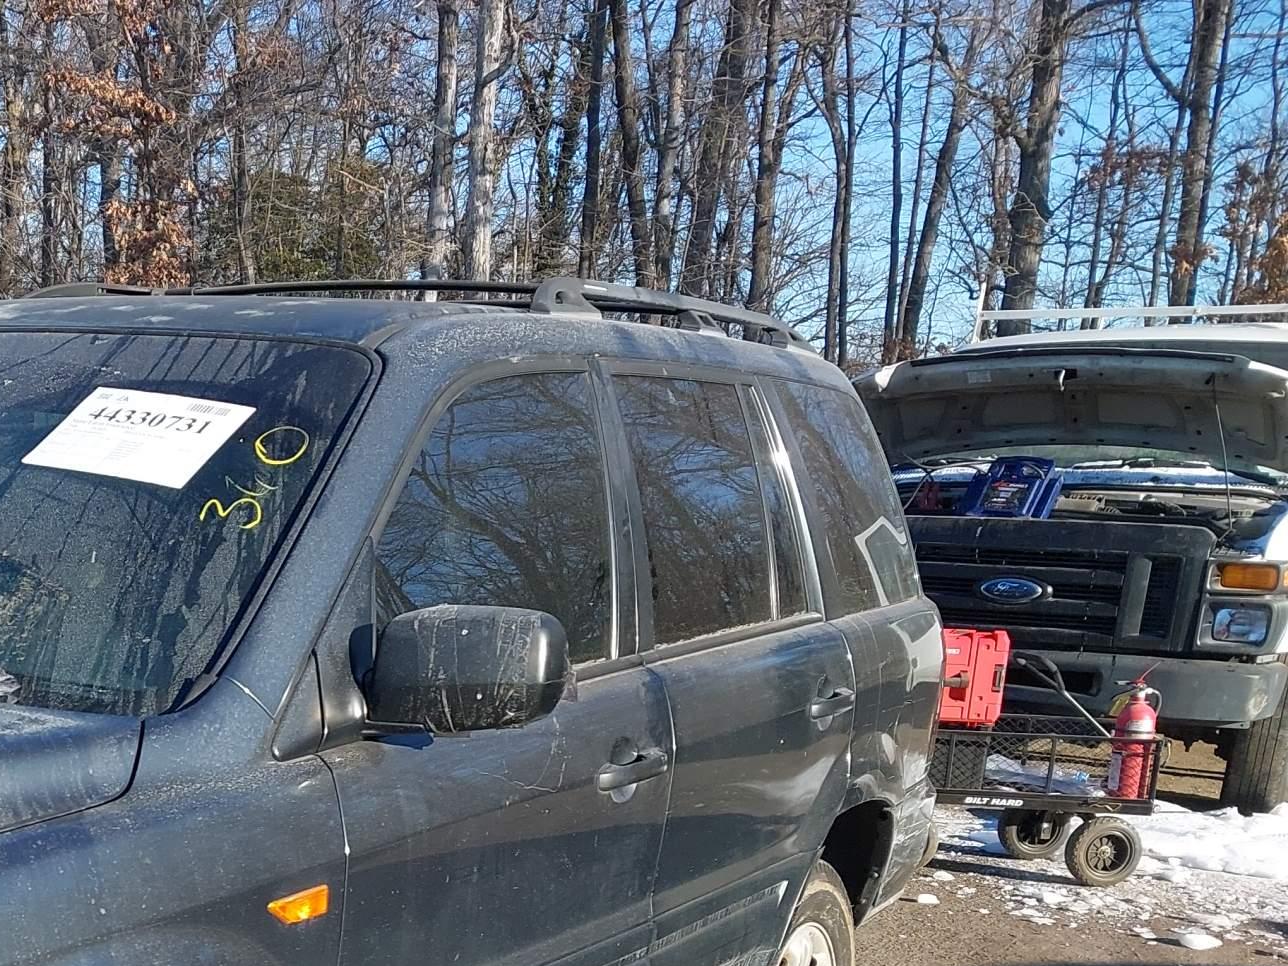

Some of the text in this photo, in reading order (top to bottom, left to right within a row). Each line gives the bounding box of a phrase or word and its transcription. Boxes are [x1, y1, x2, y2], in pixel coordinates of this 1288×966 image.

[89, 406, 212, 434] 44330731
[964, 796, 1024, 807] BILT HARD
